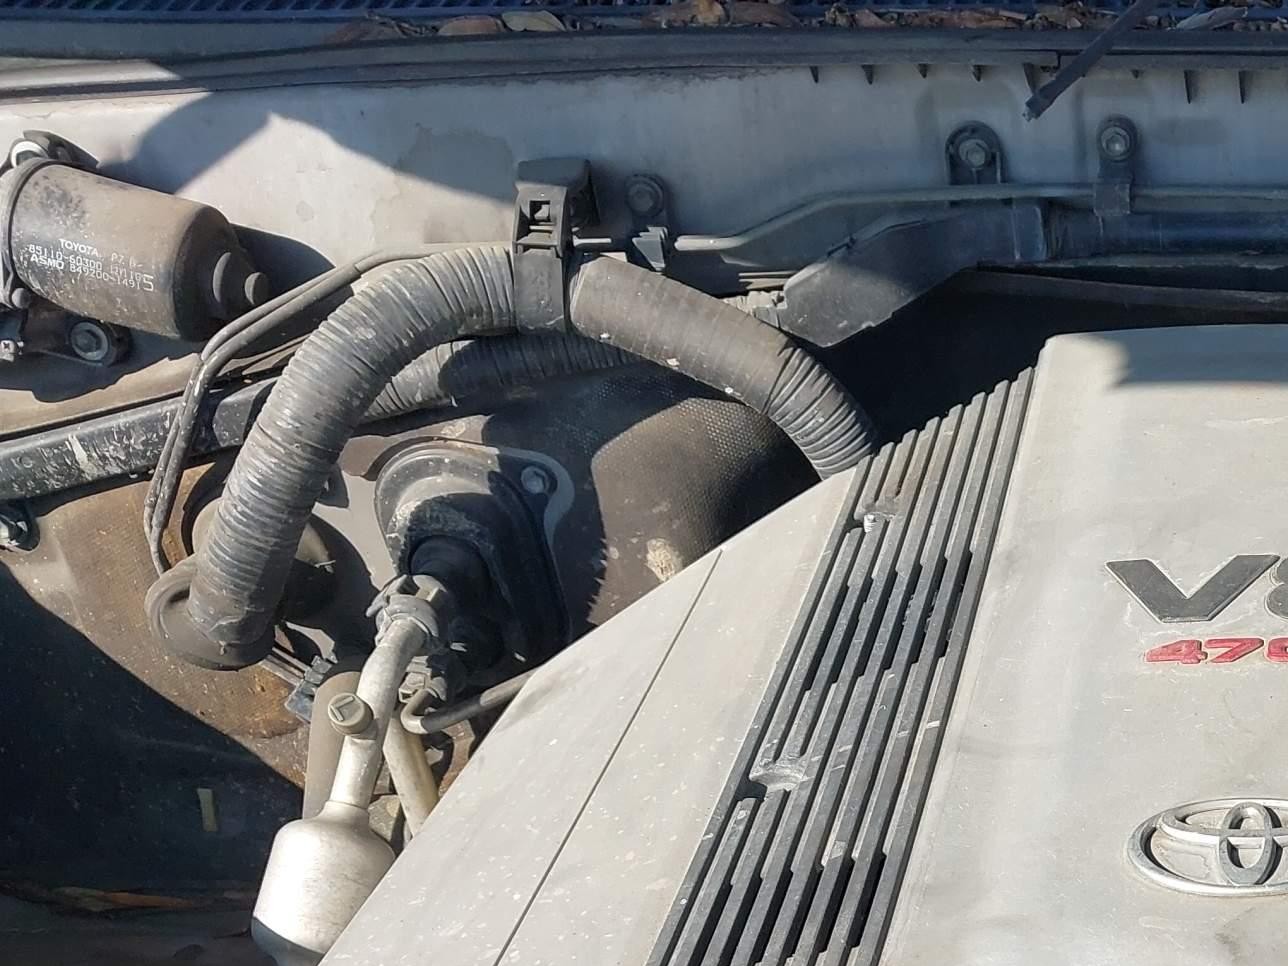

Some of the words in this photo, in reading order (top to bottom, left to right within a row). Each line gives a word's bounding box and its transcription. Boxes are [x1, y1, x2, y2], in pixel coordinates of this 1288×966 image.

[59, 239, 99, 257] TOYOTA
[30, 254, 65, 270] ASMO
[143, 273, 154, 292] 5
